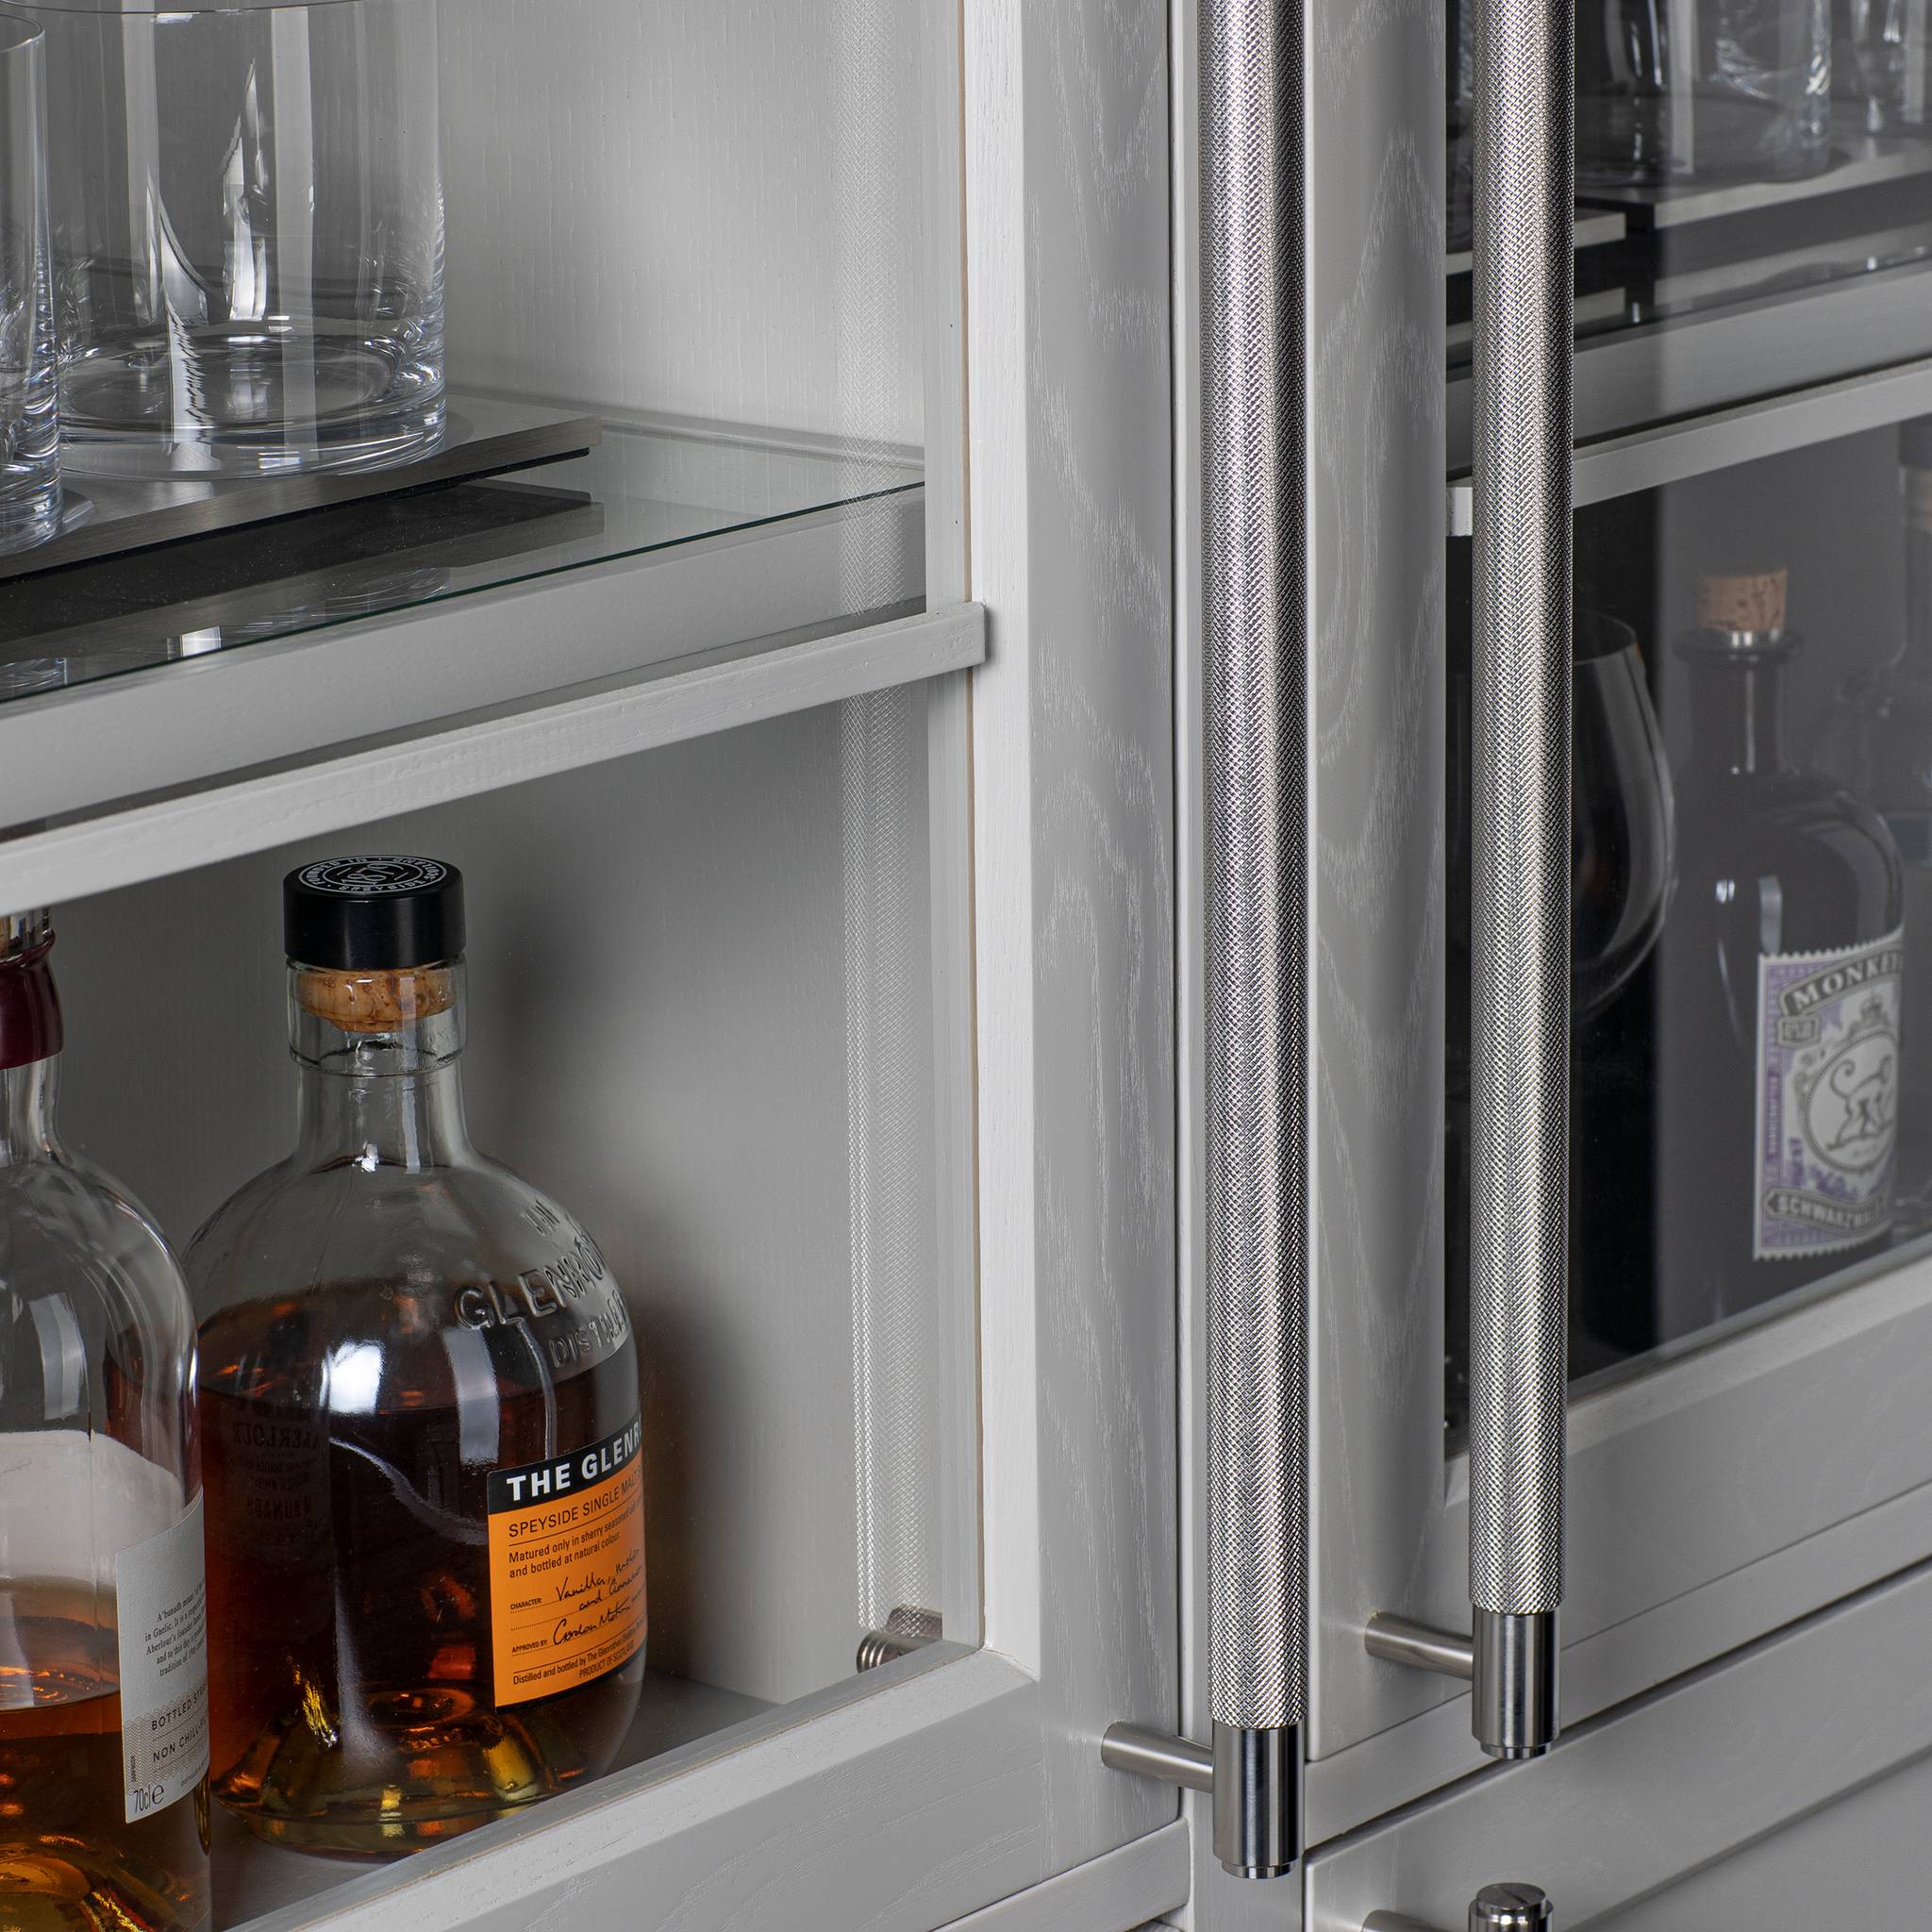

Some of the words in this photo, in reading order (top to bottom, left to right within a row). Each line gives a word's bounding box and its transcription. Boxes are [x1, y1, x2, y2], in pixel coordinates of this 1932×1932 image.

[507, 1462, 571, 1501] THE
[581, 1415, 641, 1479] GLENR
[509, 1507, 578, 1538] SPEYSIDE
[583, 1487, 619, 1516] SINGLE
[509, 1544, 550, 1562] Matured
[552, 1539, 570, 1553] only
[572, 1536, 579, 1547] in
[581, 1525, 604, 1543] sherry
[509, 1565, 528, 1577] and
[531, 1557, 562, 1574] bottled
[564, 1553, 573, 1564] at
[575, 1542, 601, 1559] natural
[144, 1633, 151, 1641] in
[511, 1641, 539, 1654] APPROVED
[157, 1651, 167, 1664] and
[512, 1673, 541, 1685] Distilled
[542, 1668, 556, 1677] and
[557, 1659, 578, 1674] bottled
[587, 1651, 597, 1661] The
[579, 1660, 605, 1678] PRODUCT
[151, 1699, 192, 1731] BOTTLED
[152, 1742, 176, 1762] NON
